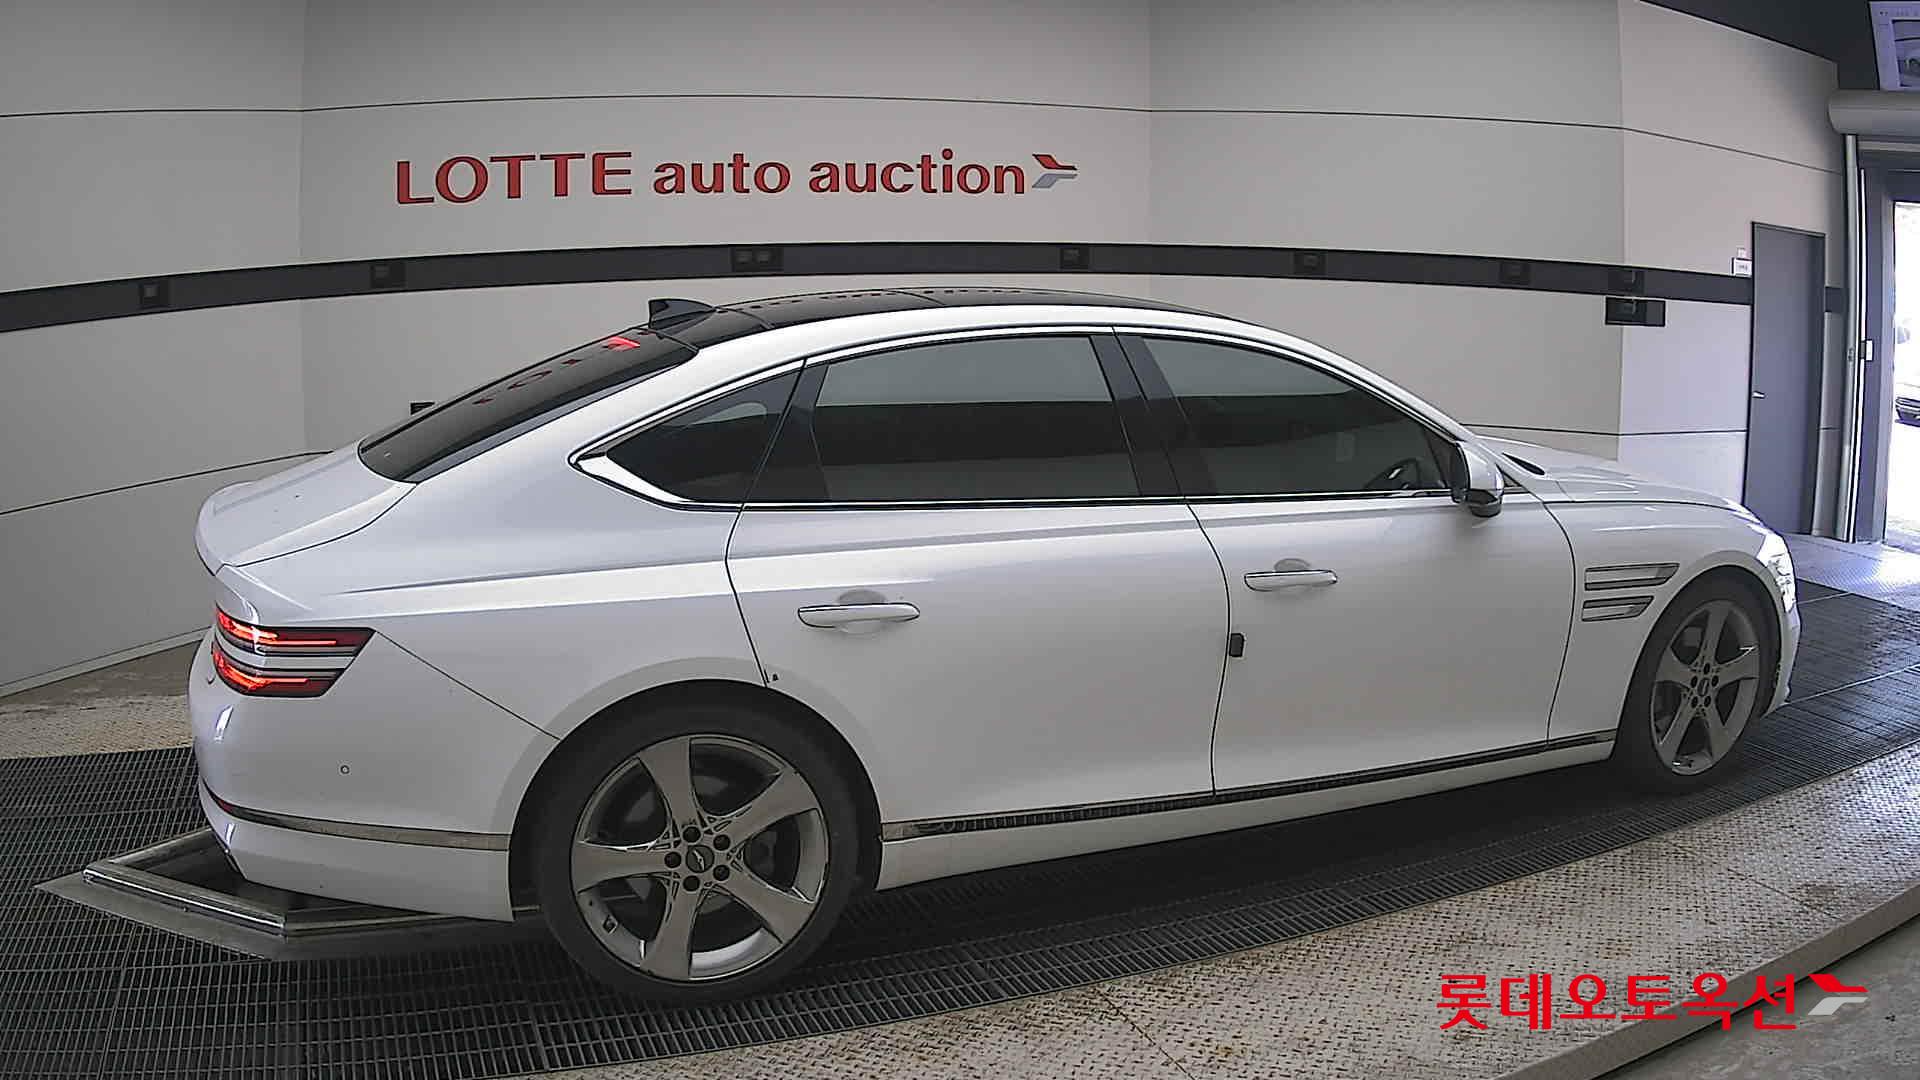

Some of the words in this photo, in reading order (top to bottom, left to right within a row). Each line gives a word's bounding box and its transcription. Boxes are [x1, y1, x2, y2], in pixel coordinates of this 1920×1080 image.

[396, 151, 632, 205] LOTTE
[653, 152, 791, 194] auto
[809, 148, 1026, 195] auction
